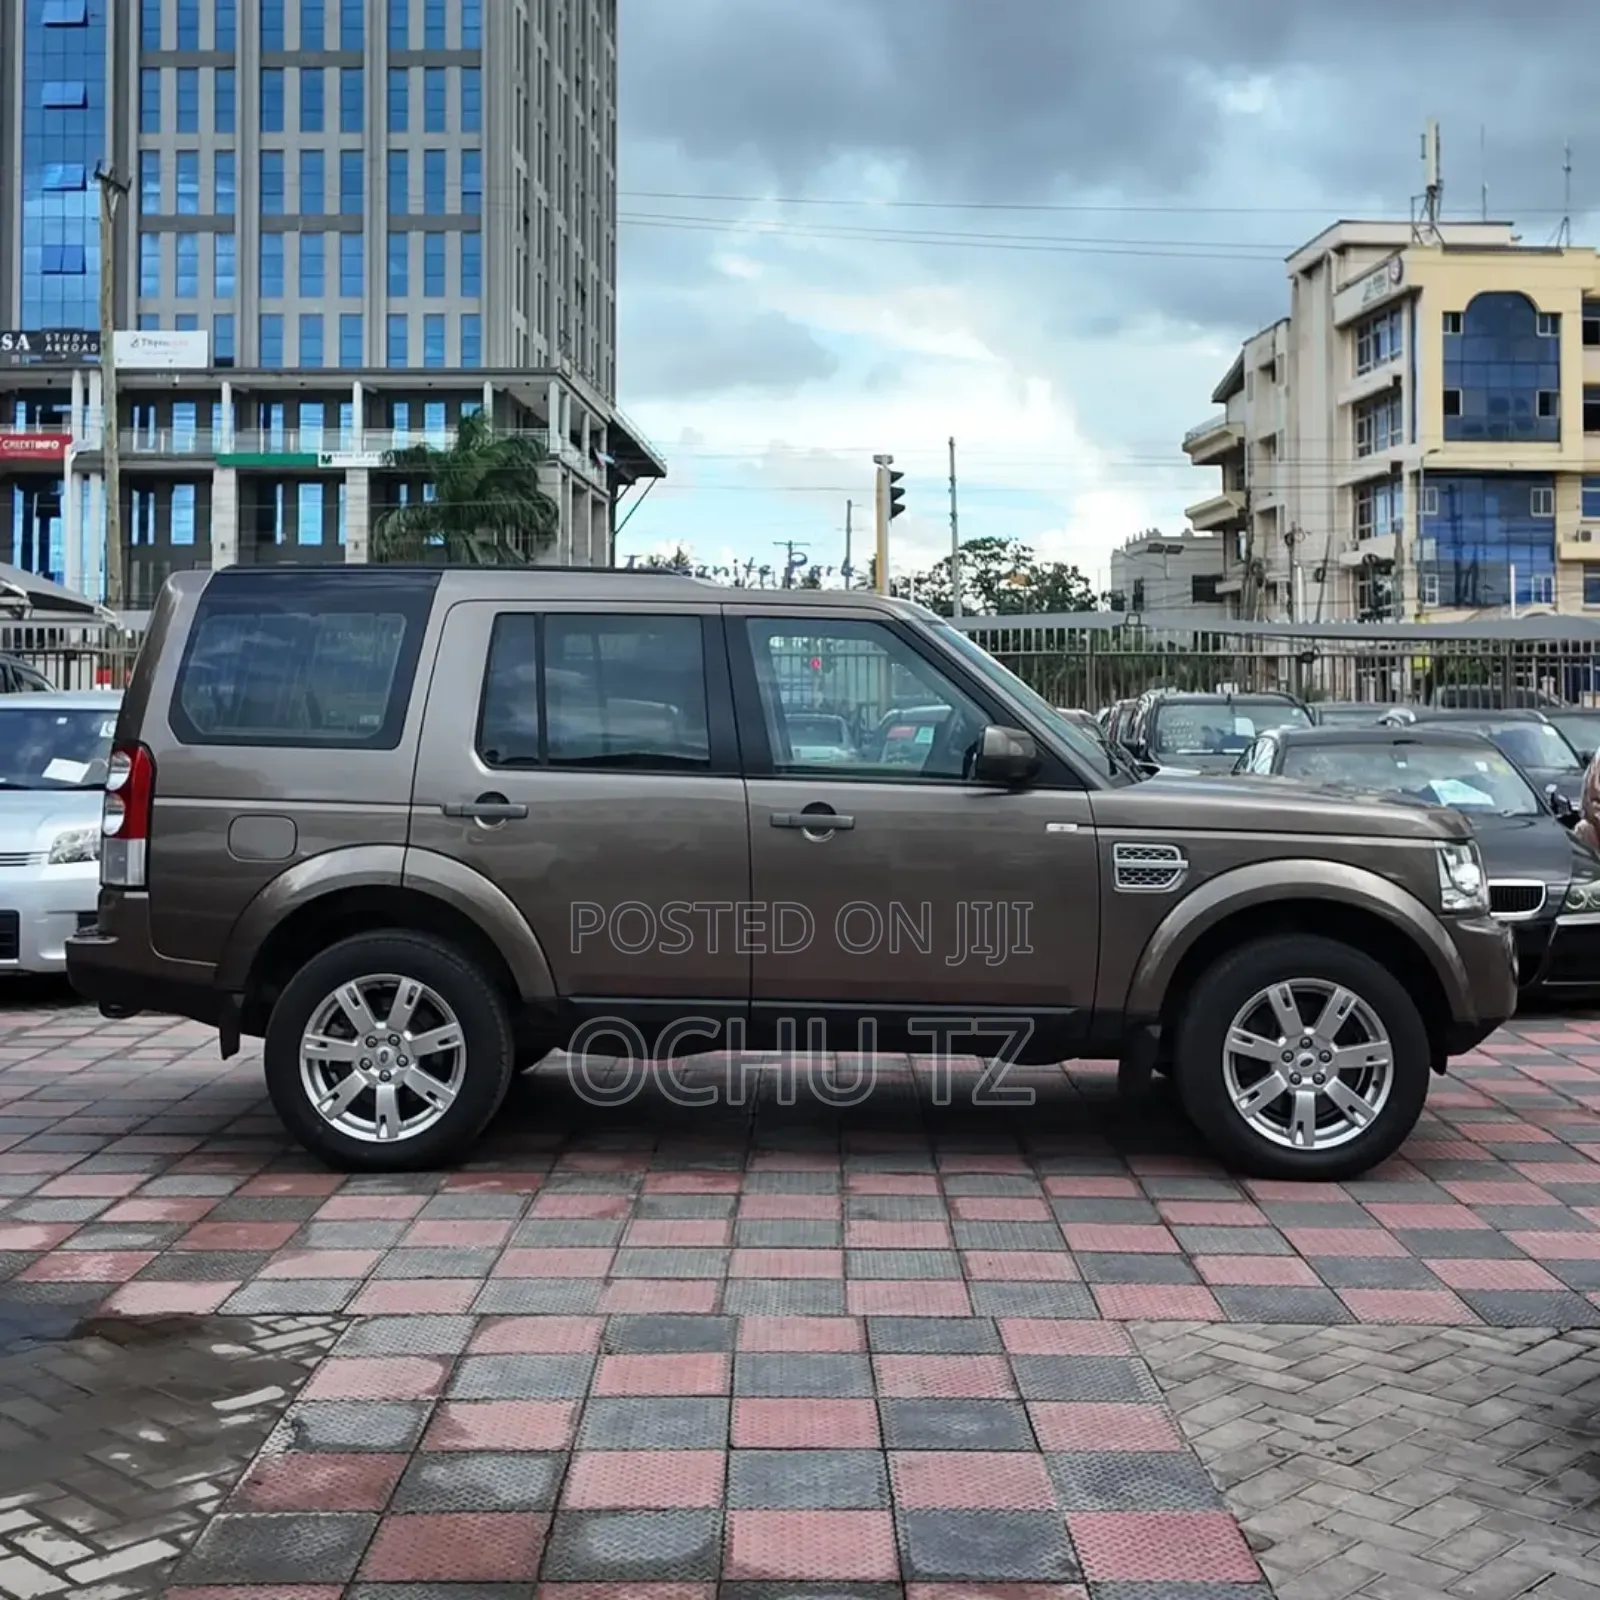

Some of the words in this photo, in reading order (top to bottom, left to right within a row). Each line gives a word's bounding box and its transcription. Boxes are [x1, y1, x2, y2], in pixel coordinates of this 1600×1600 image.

[45, 333, 89, 342] STUDY
[45, 343, 98, 352] ABROAD
[623, 554, 772, 577] Tanite
[787, 551, 855, 577] Park
